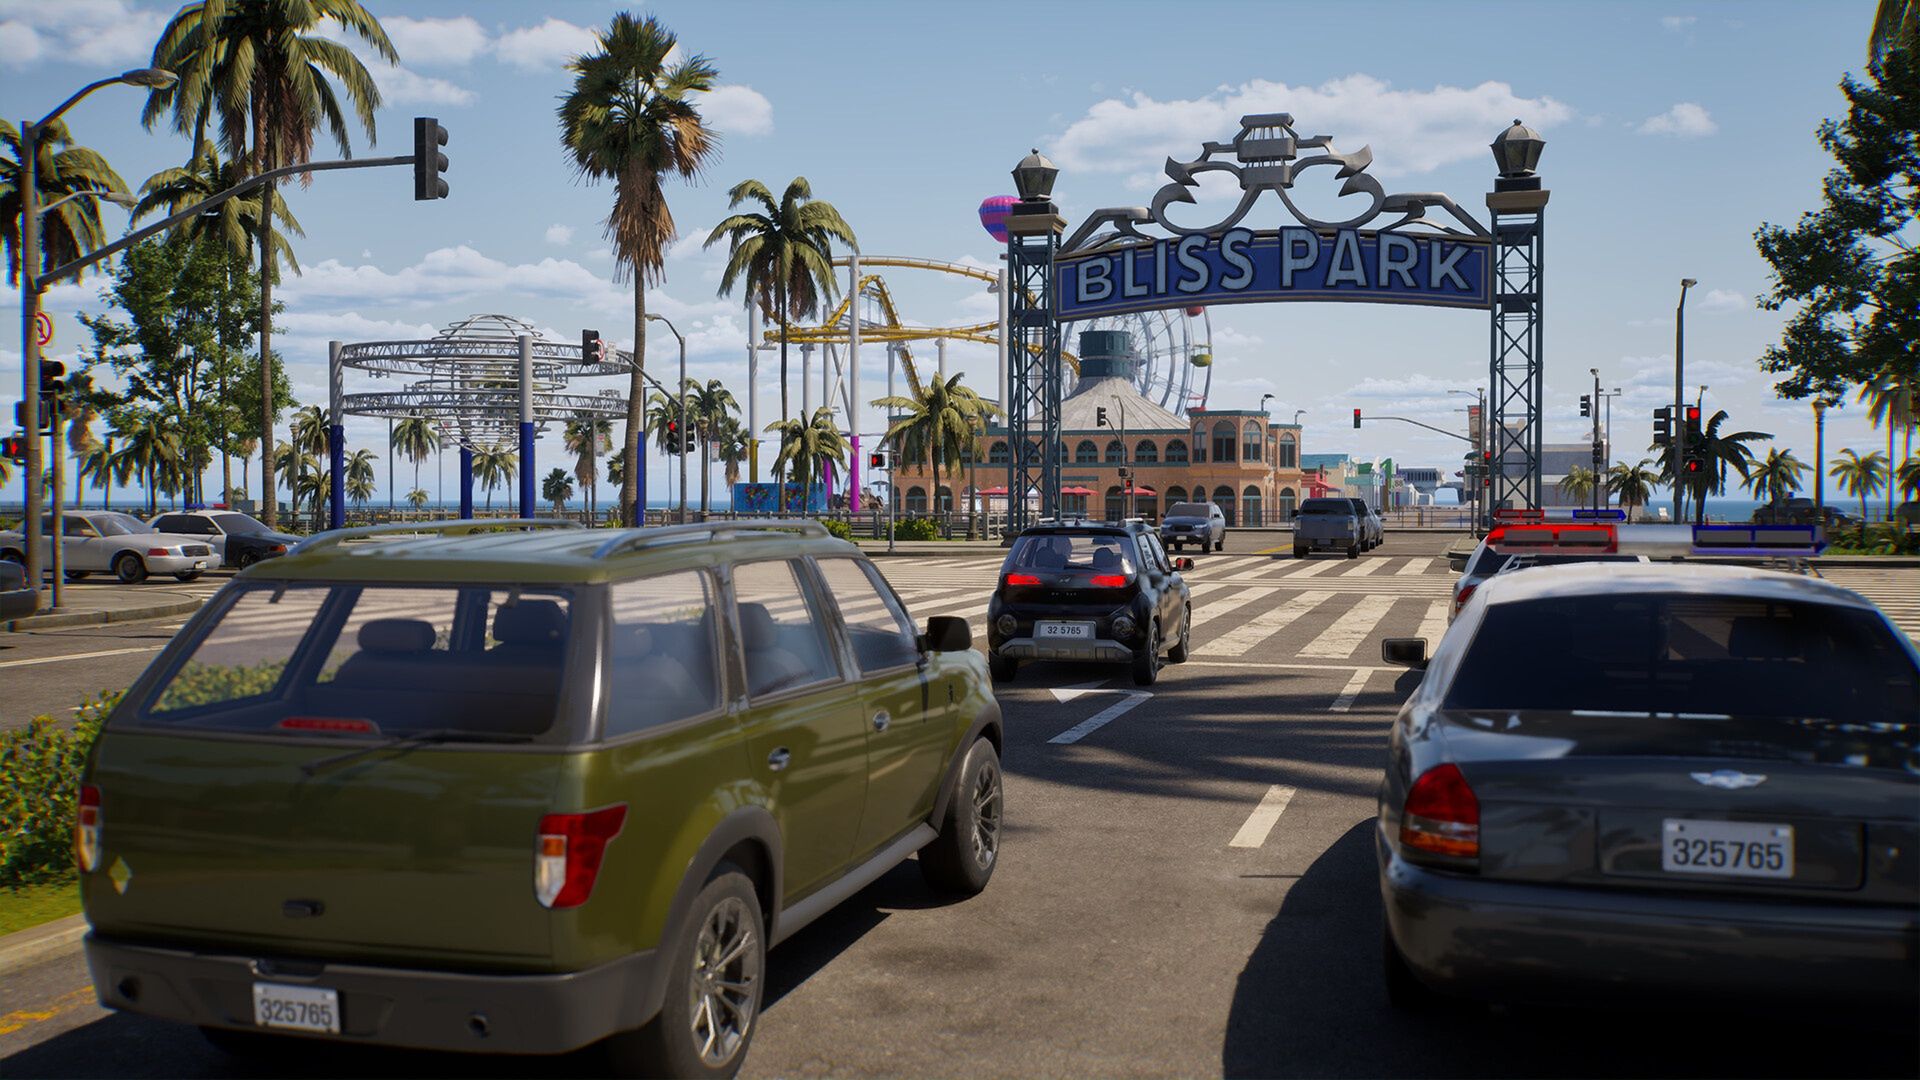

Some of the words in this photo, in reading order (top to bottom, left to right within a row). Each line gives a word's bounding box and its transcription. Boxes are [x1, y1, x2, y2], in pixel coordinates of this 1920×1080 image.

[1077, 228, 1255, 302] BLISS
[1281, 227, 1471, 290] PARK
[1047, 626, 1058, 634] 32
[1673, 838, 1783, 870] 325765
[260, 998, 333, 1027] 325765
